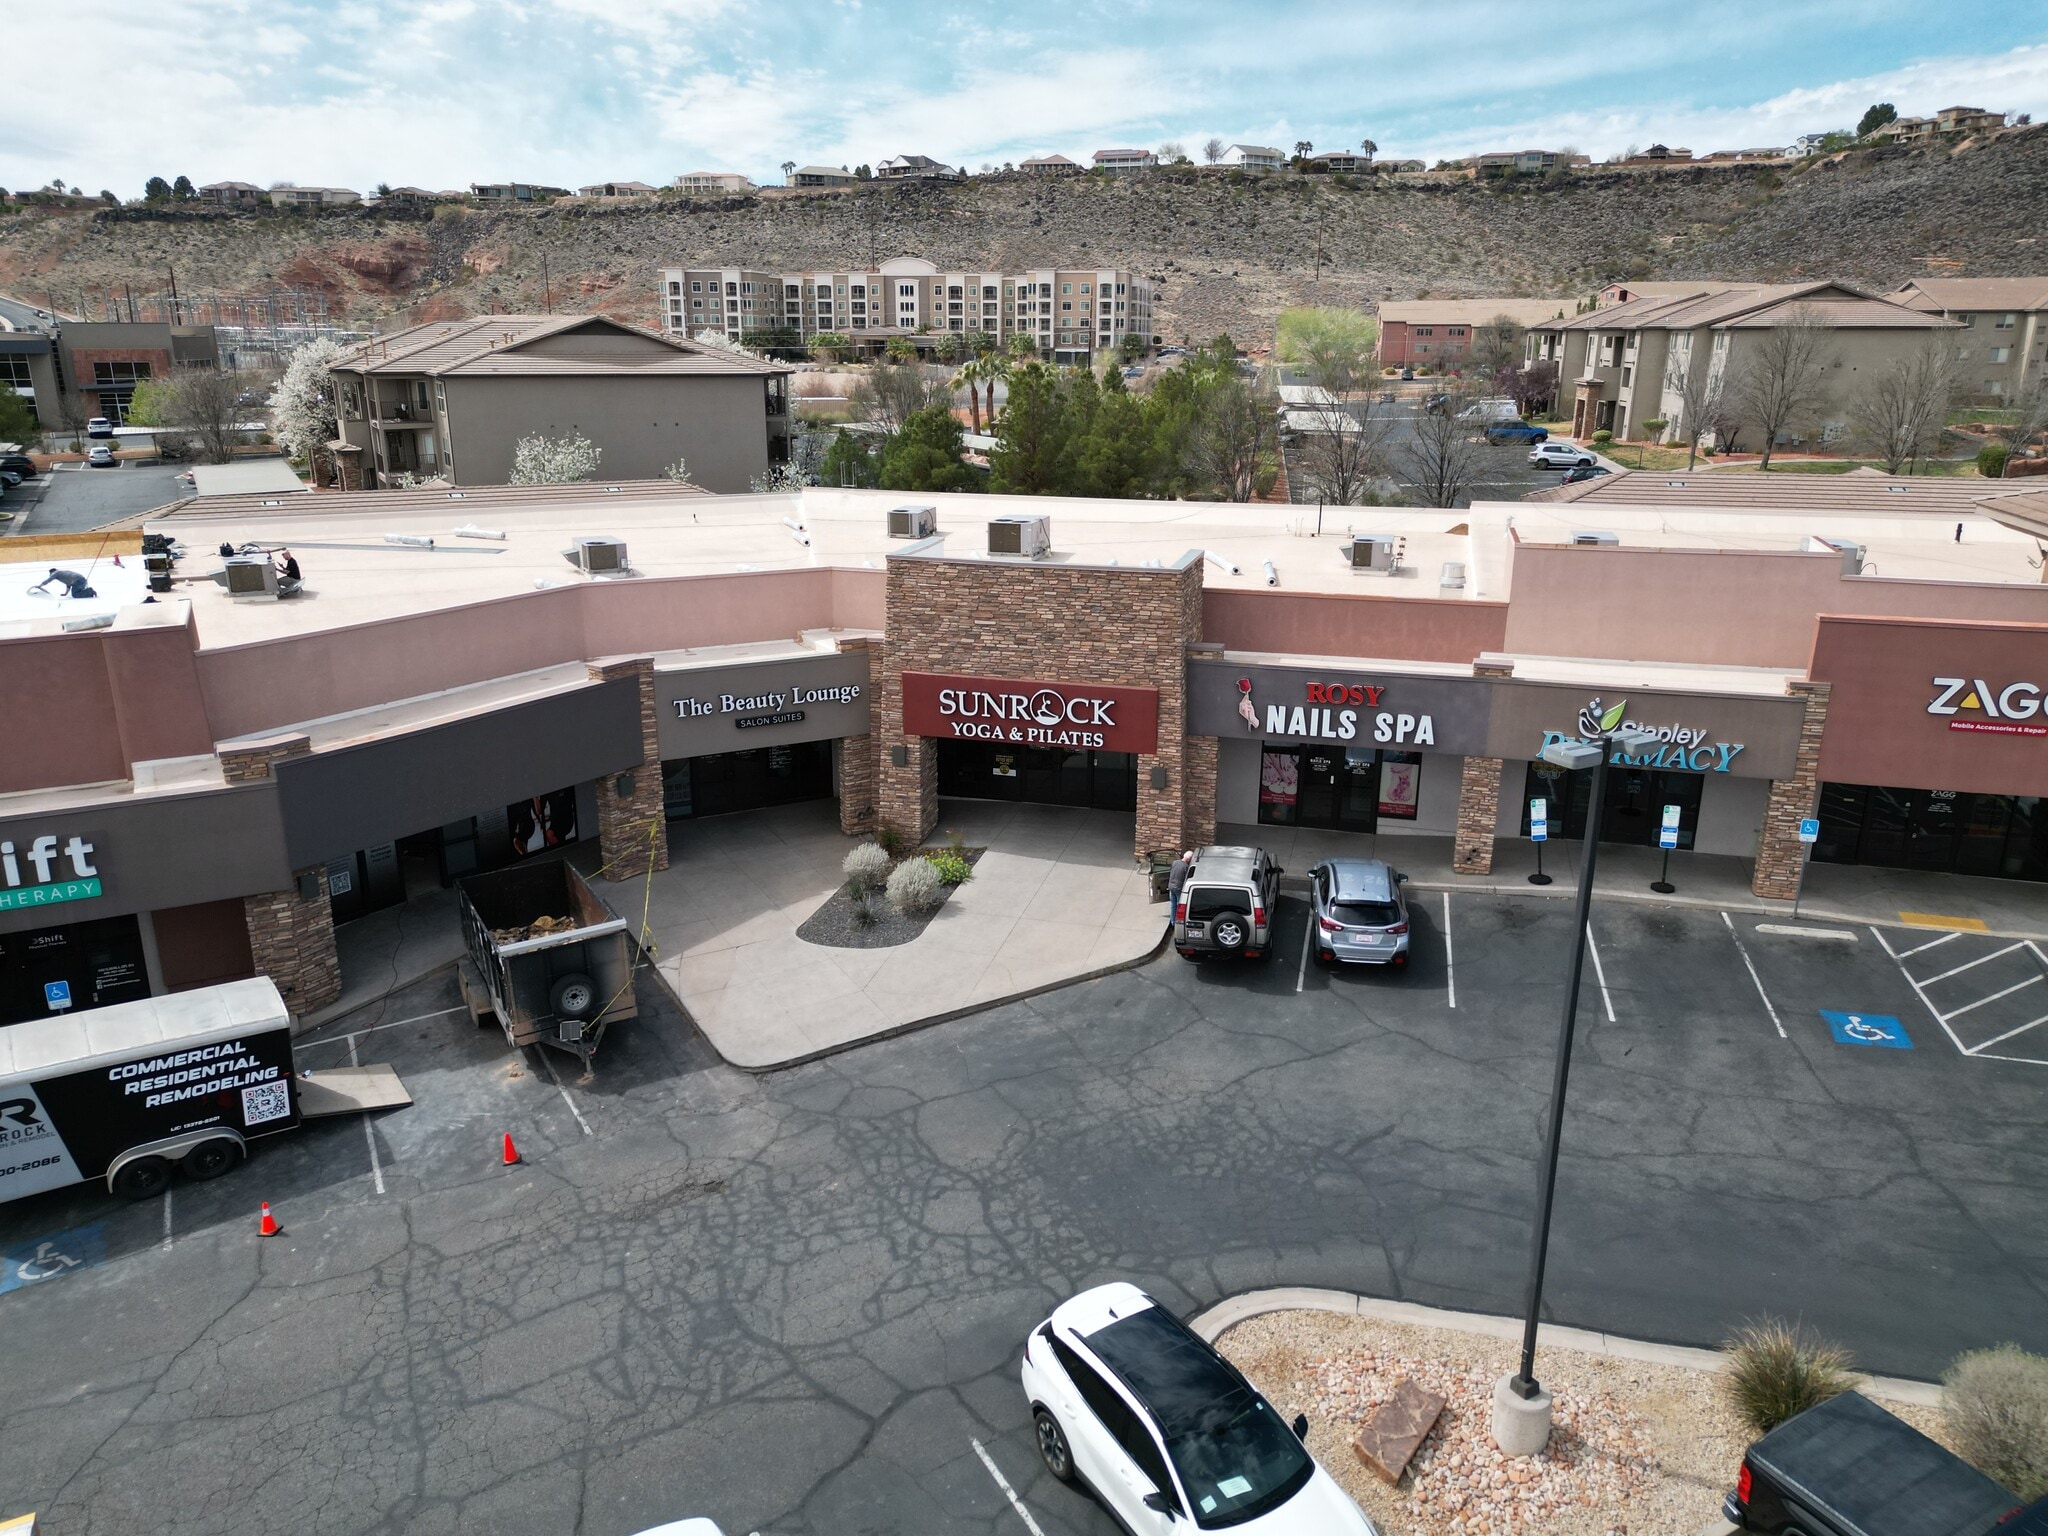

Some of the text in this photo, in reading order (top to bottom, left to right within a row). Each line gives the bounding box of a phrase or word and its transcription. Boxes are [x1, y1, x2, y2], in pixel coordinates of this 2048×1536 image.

[673, 685, 860, 718] The Beauty Lounge
[1306, 681, 1385, 707] ROSY
[1927, 677, 2048, 720] ZAG
[740, 712, 802, 728] SALON SUITES
[1266, 705, 1435, 745] NAILS SPA
[951, 722, 1104, 747] YOGA & PILATES
[1536, 730, 1744, 772] PMACY
[1931, 790, 1956, 798] ZAGG
[0, 883, 93, 907] HERAPY
[38, 934, 64, 944] Shift
[109, 1041, 246, 1081] COMMERCIAL
[125, 1055, 260, 1095] RESIDENTIAL
[145, 1066, 279, 1108] REMODELING
[0, 1124, 47, 1143] ROCK
[18, 1132, 56, 1143] REMODEL
